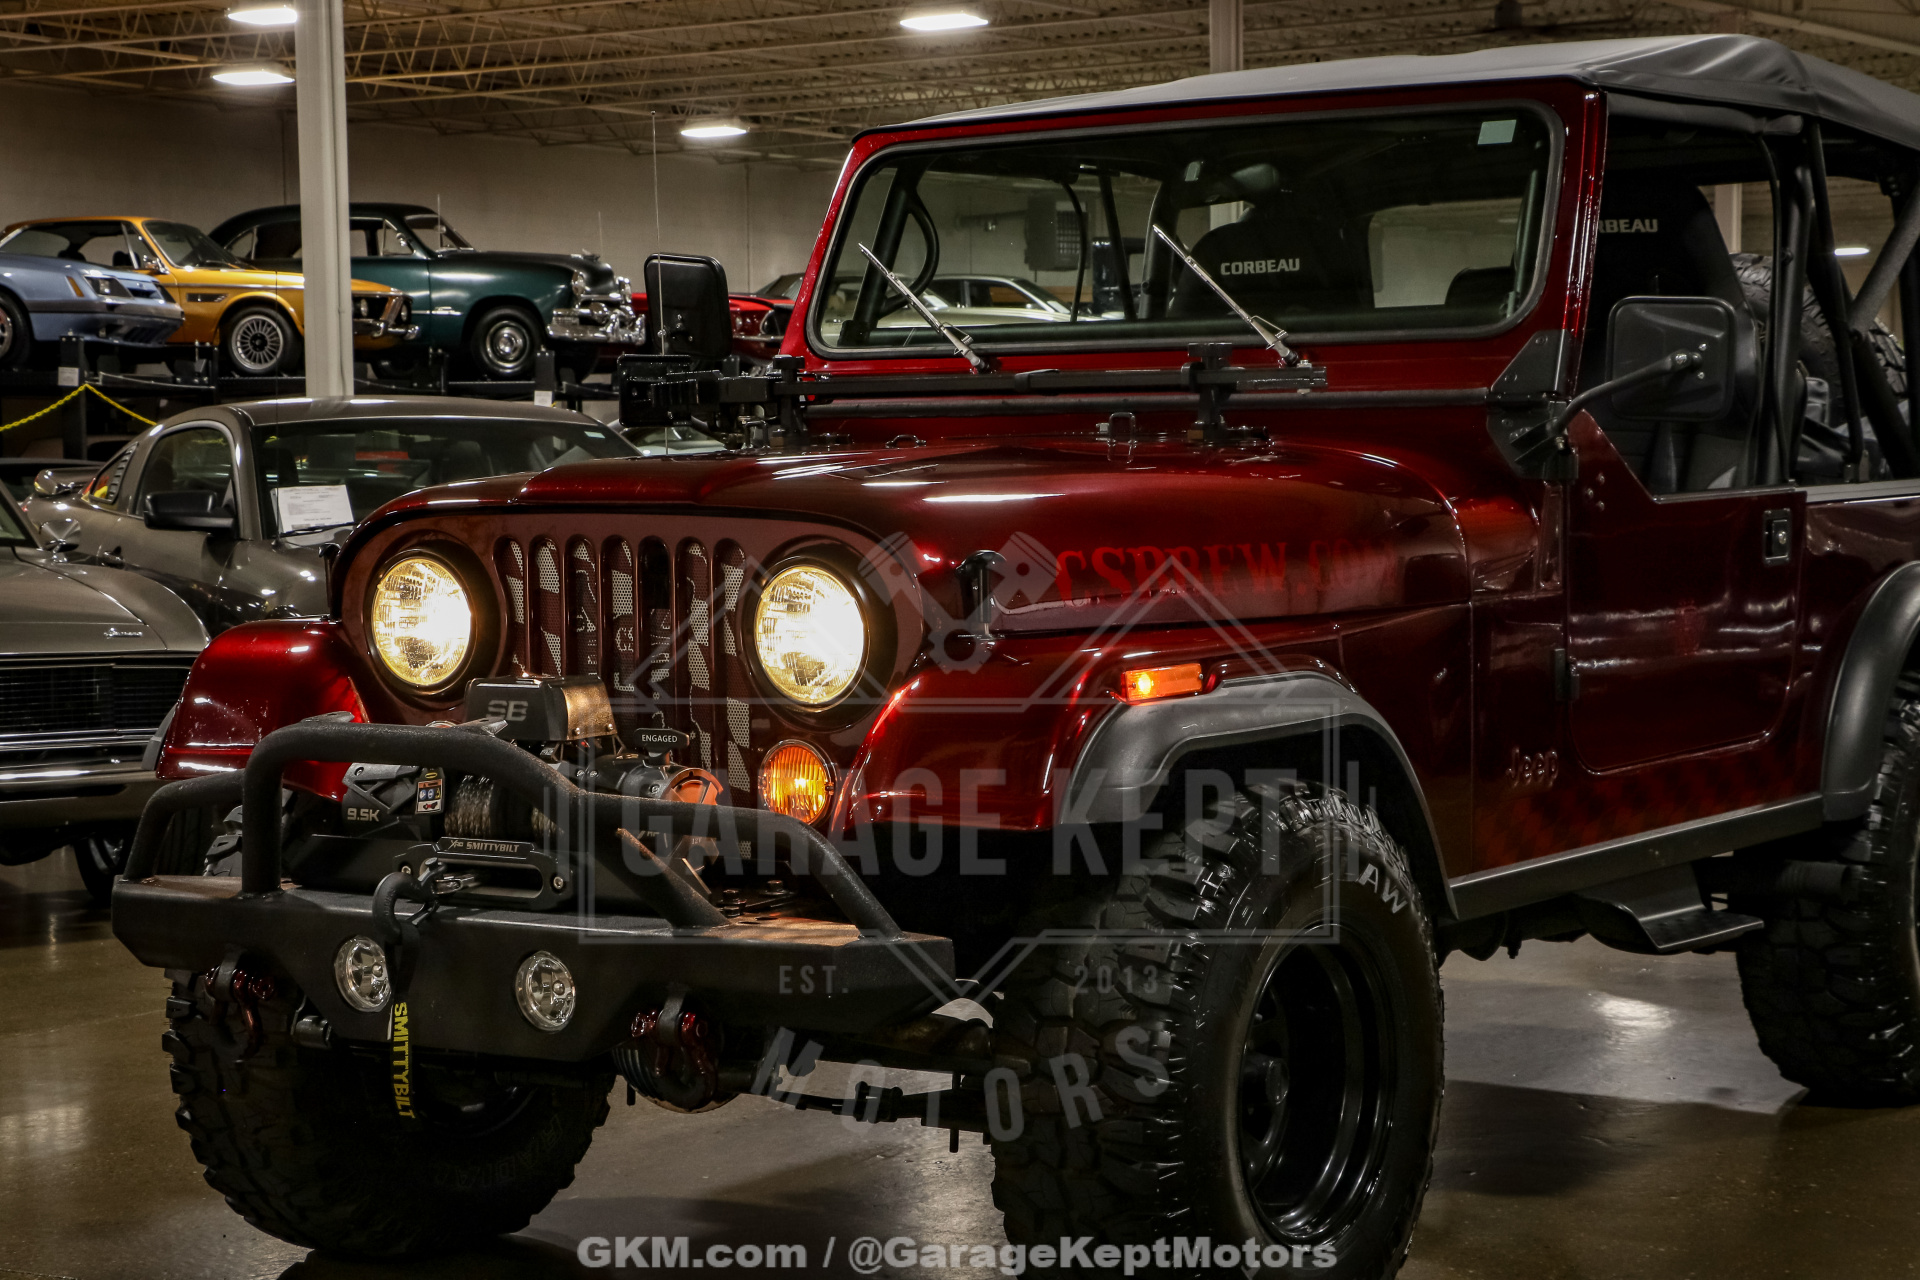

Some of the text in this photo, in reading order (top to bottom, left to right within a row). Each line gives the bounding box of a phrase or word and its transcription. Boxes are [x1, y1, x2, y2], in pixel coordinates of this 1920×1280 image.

[1220, 257, 1300, 276] CORBEAU
[641, 733, 679, 744] ENGAGED
[1505, 745, 1559, 789] Jeep
[346, 807, 380, 822] 9.5K
[466, 841, 520, 853] SMITTYBILT
[393, 1002, 417, 1119] SMITTYBILT
